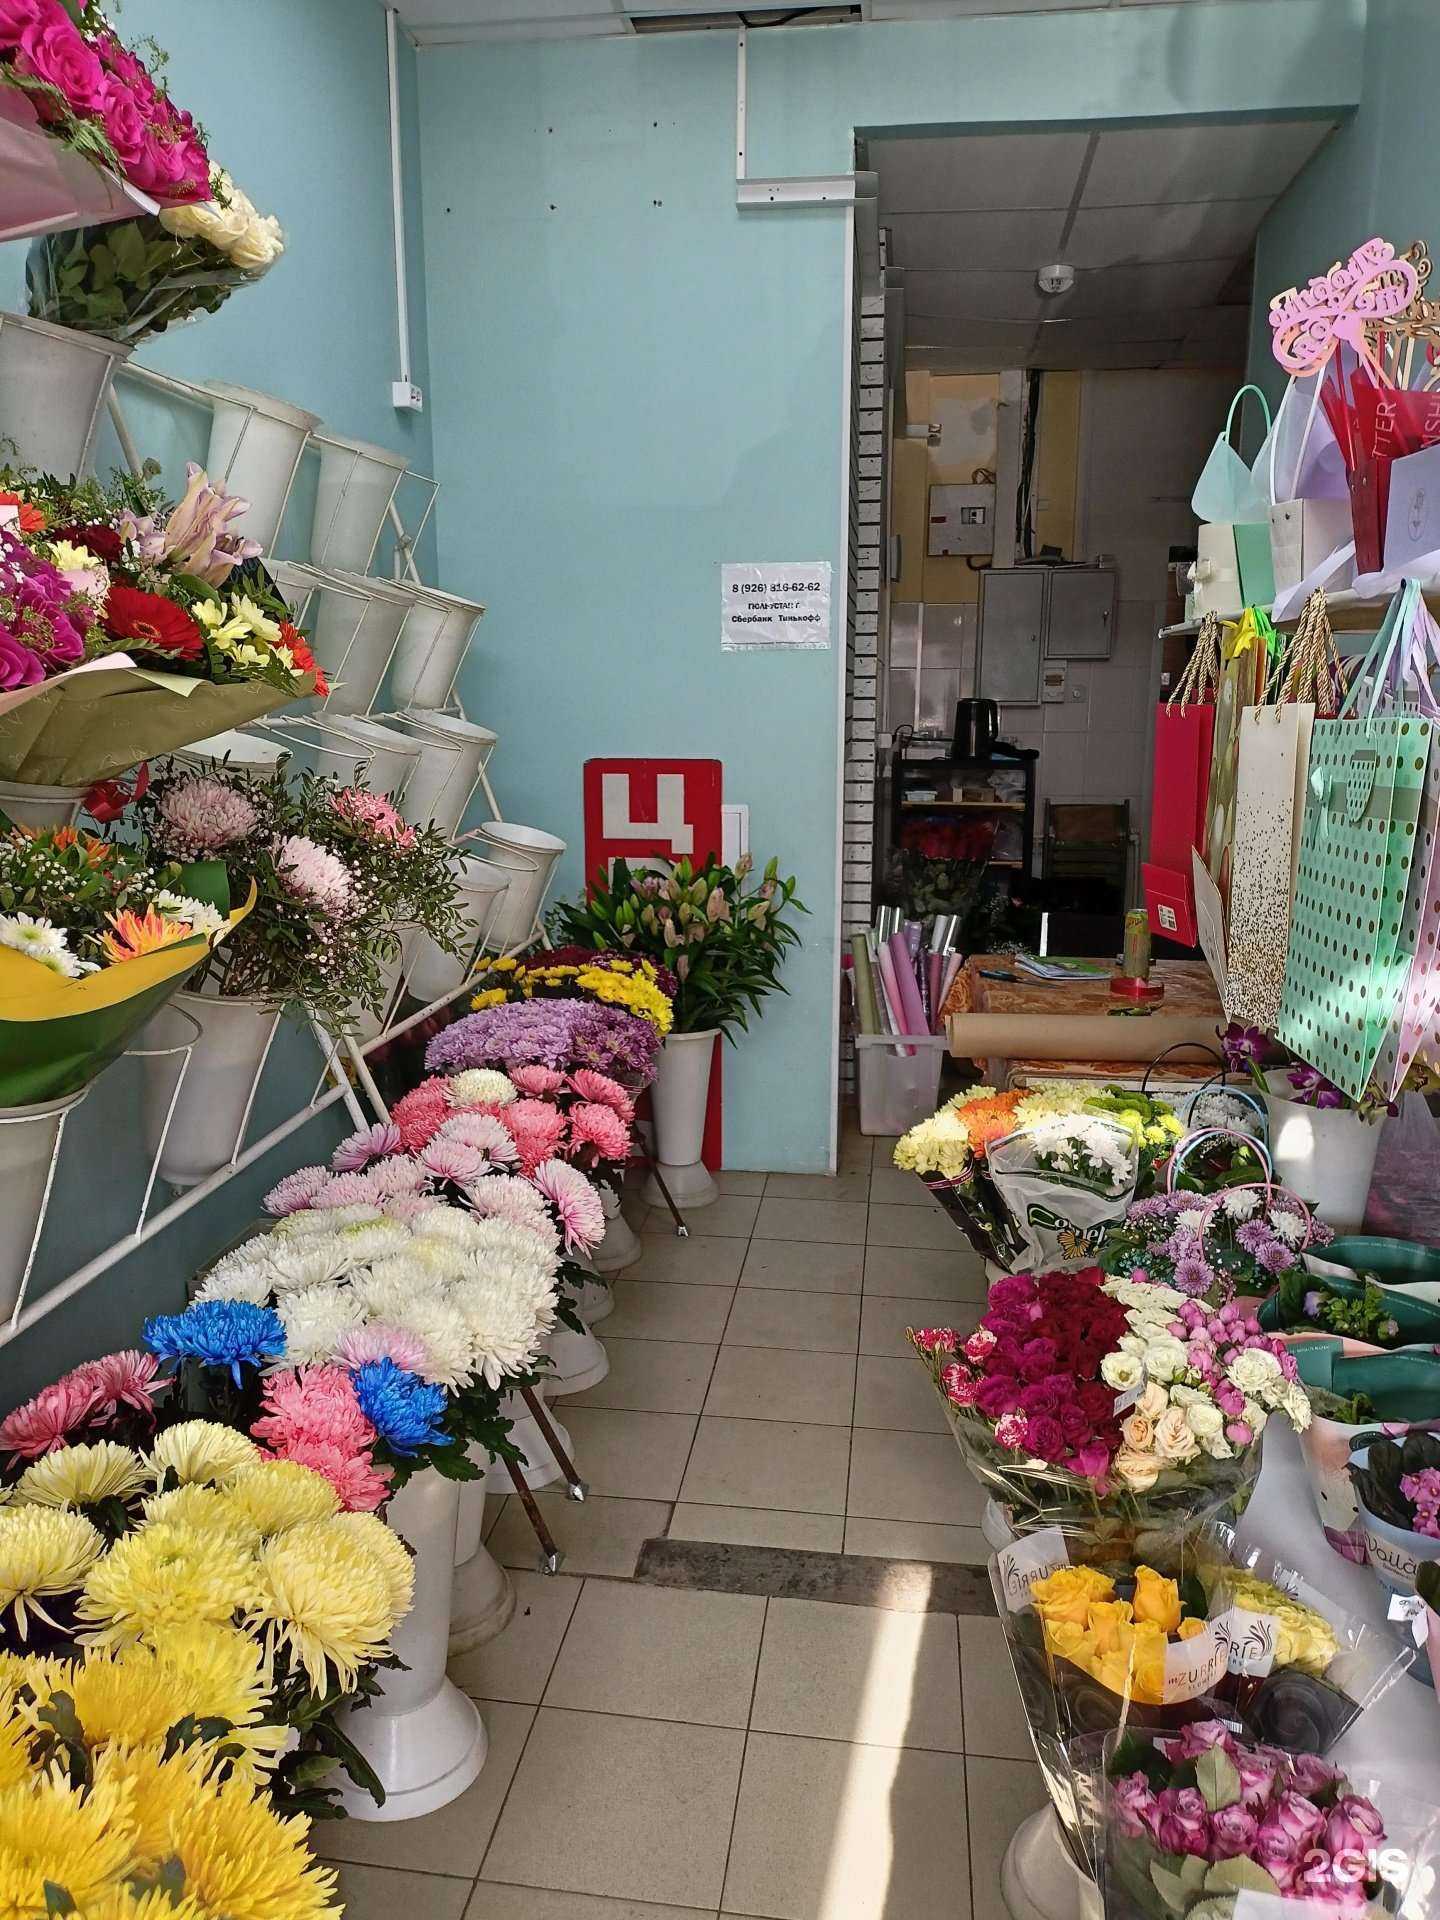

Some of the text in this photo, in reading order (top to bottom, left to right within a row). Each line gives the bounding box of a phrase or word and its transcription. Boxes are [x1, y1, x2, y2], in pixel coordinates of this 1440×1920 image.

[732, 584, 739, 593] 8
[741, 583, 767, 594] (926)
[731, 614, 821, 623] Сбербанк Тинькофф
